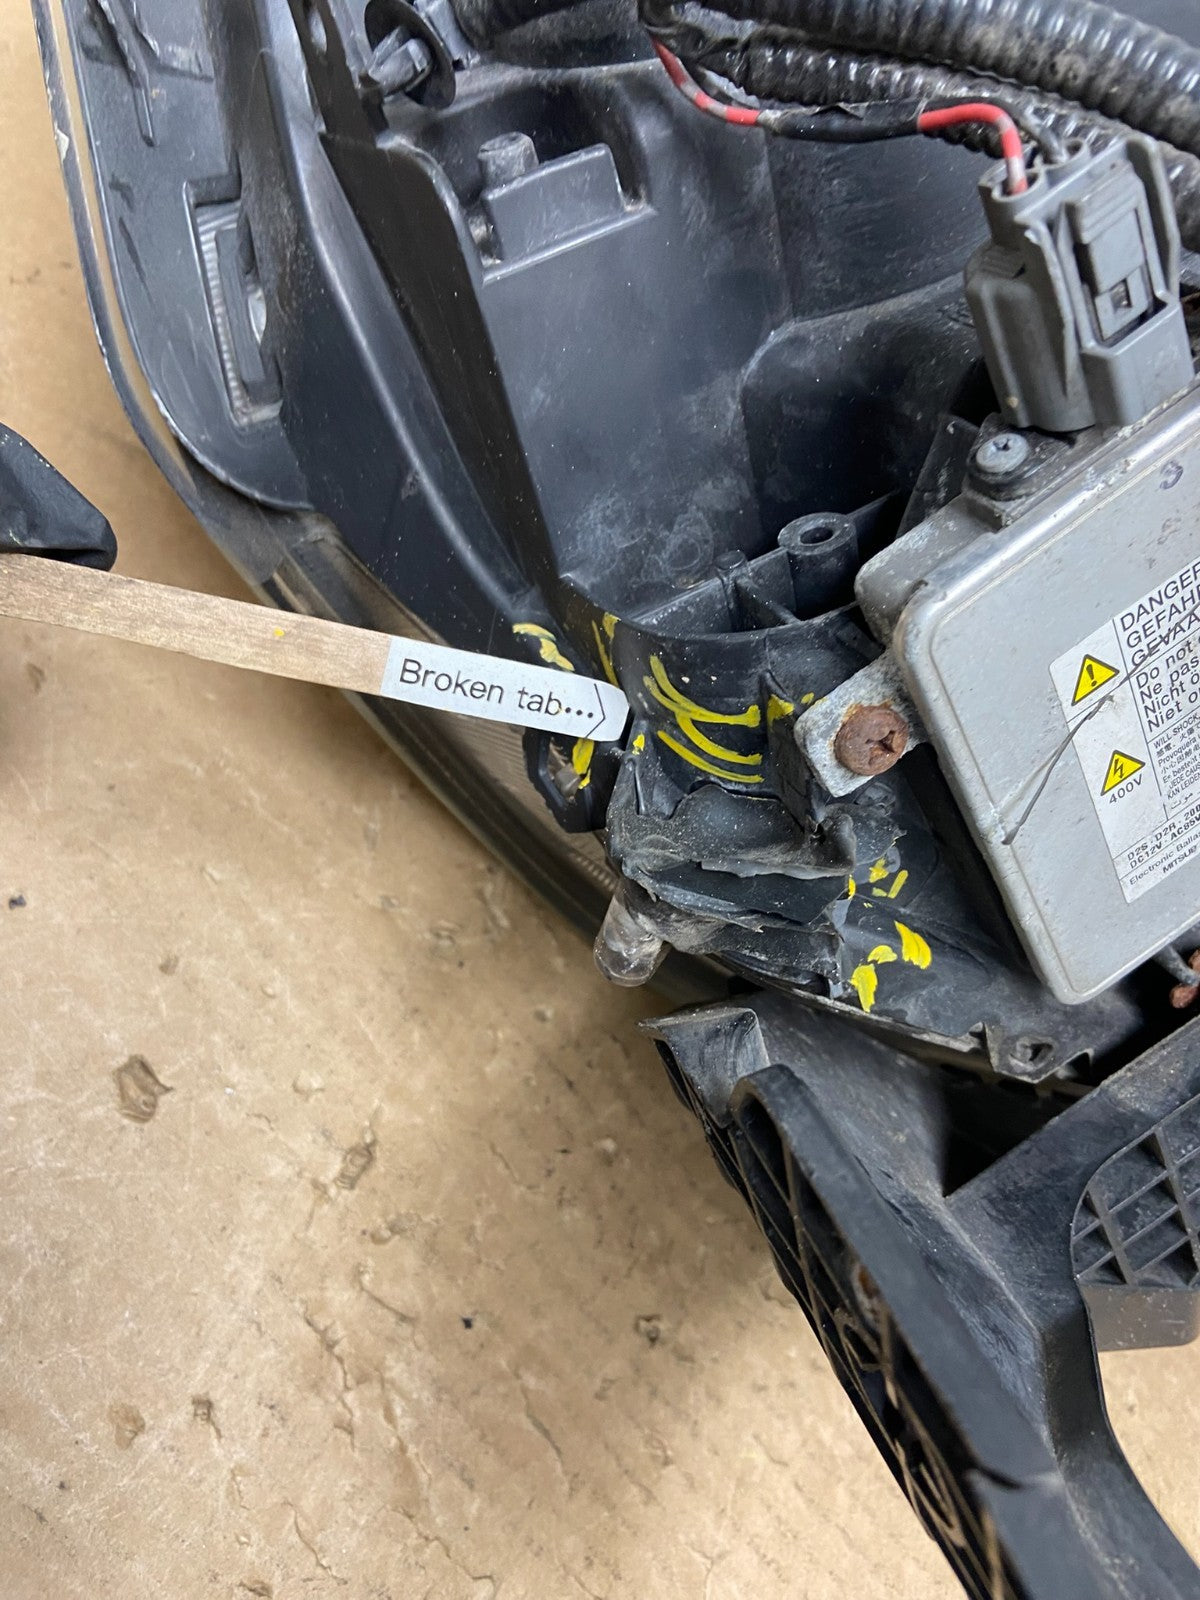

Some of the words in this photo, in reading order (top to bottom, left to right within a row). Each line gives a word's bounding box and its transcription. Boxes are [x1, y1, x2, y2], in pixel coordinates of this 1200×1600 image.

[1126, 584, 1200, 648] GEFAH
[399, 658, 504, 704] Broken
[1136, 667, 1160, 689] Do
[1166, 640, 1193, 669] not
[1140, 682, 1163, 704] Ne
[1170, 656, 1200, 687] pas
[1144, 681, 1186, 718] Nicht
[1147, 700, 1183, 732] Niet
[1153, 734, 1172, 749] WILL
[1109, 773, 1142, 804] 400V
[1127, 842, 1148, 861] D2S
[1154, 822, 1177, 841] D2R
[1129, 841, 1162, 869] DC12V
[1129, 851, 1174, 885] Electronic
